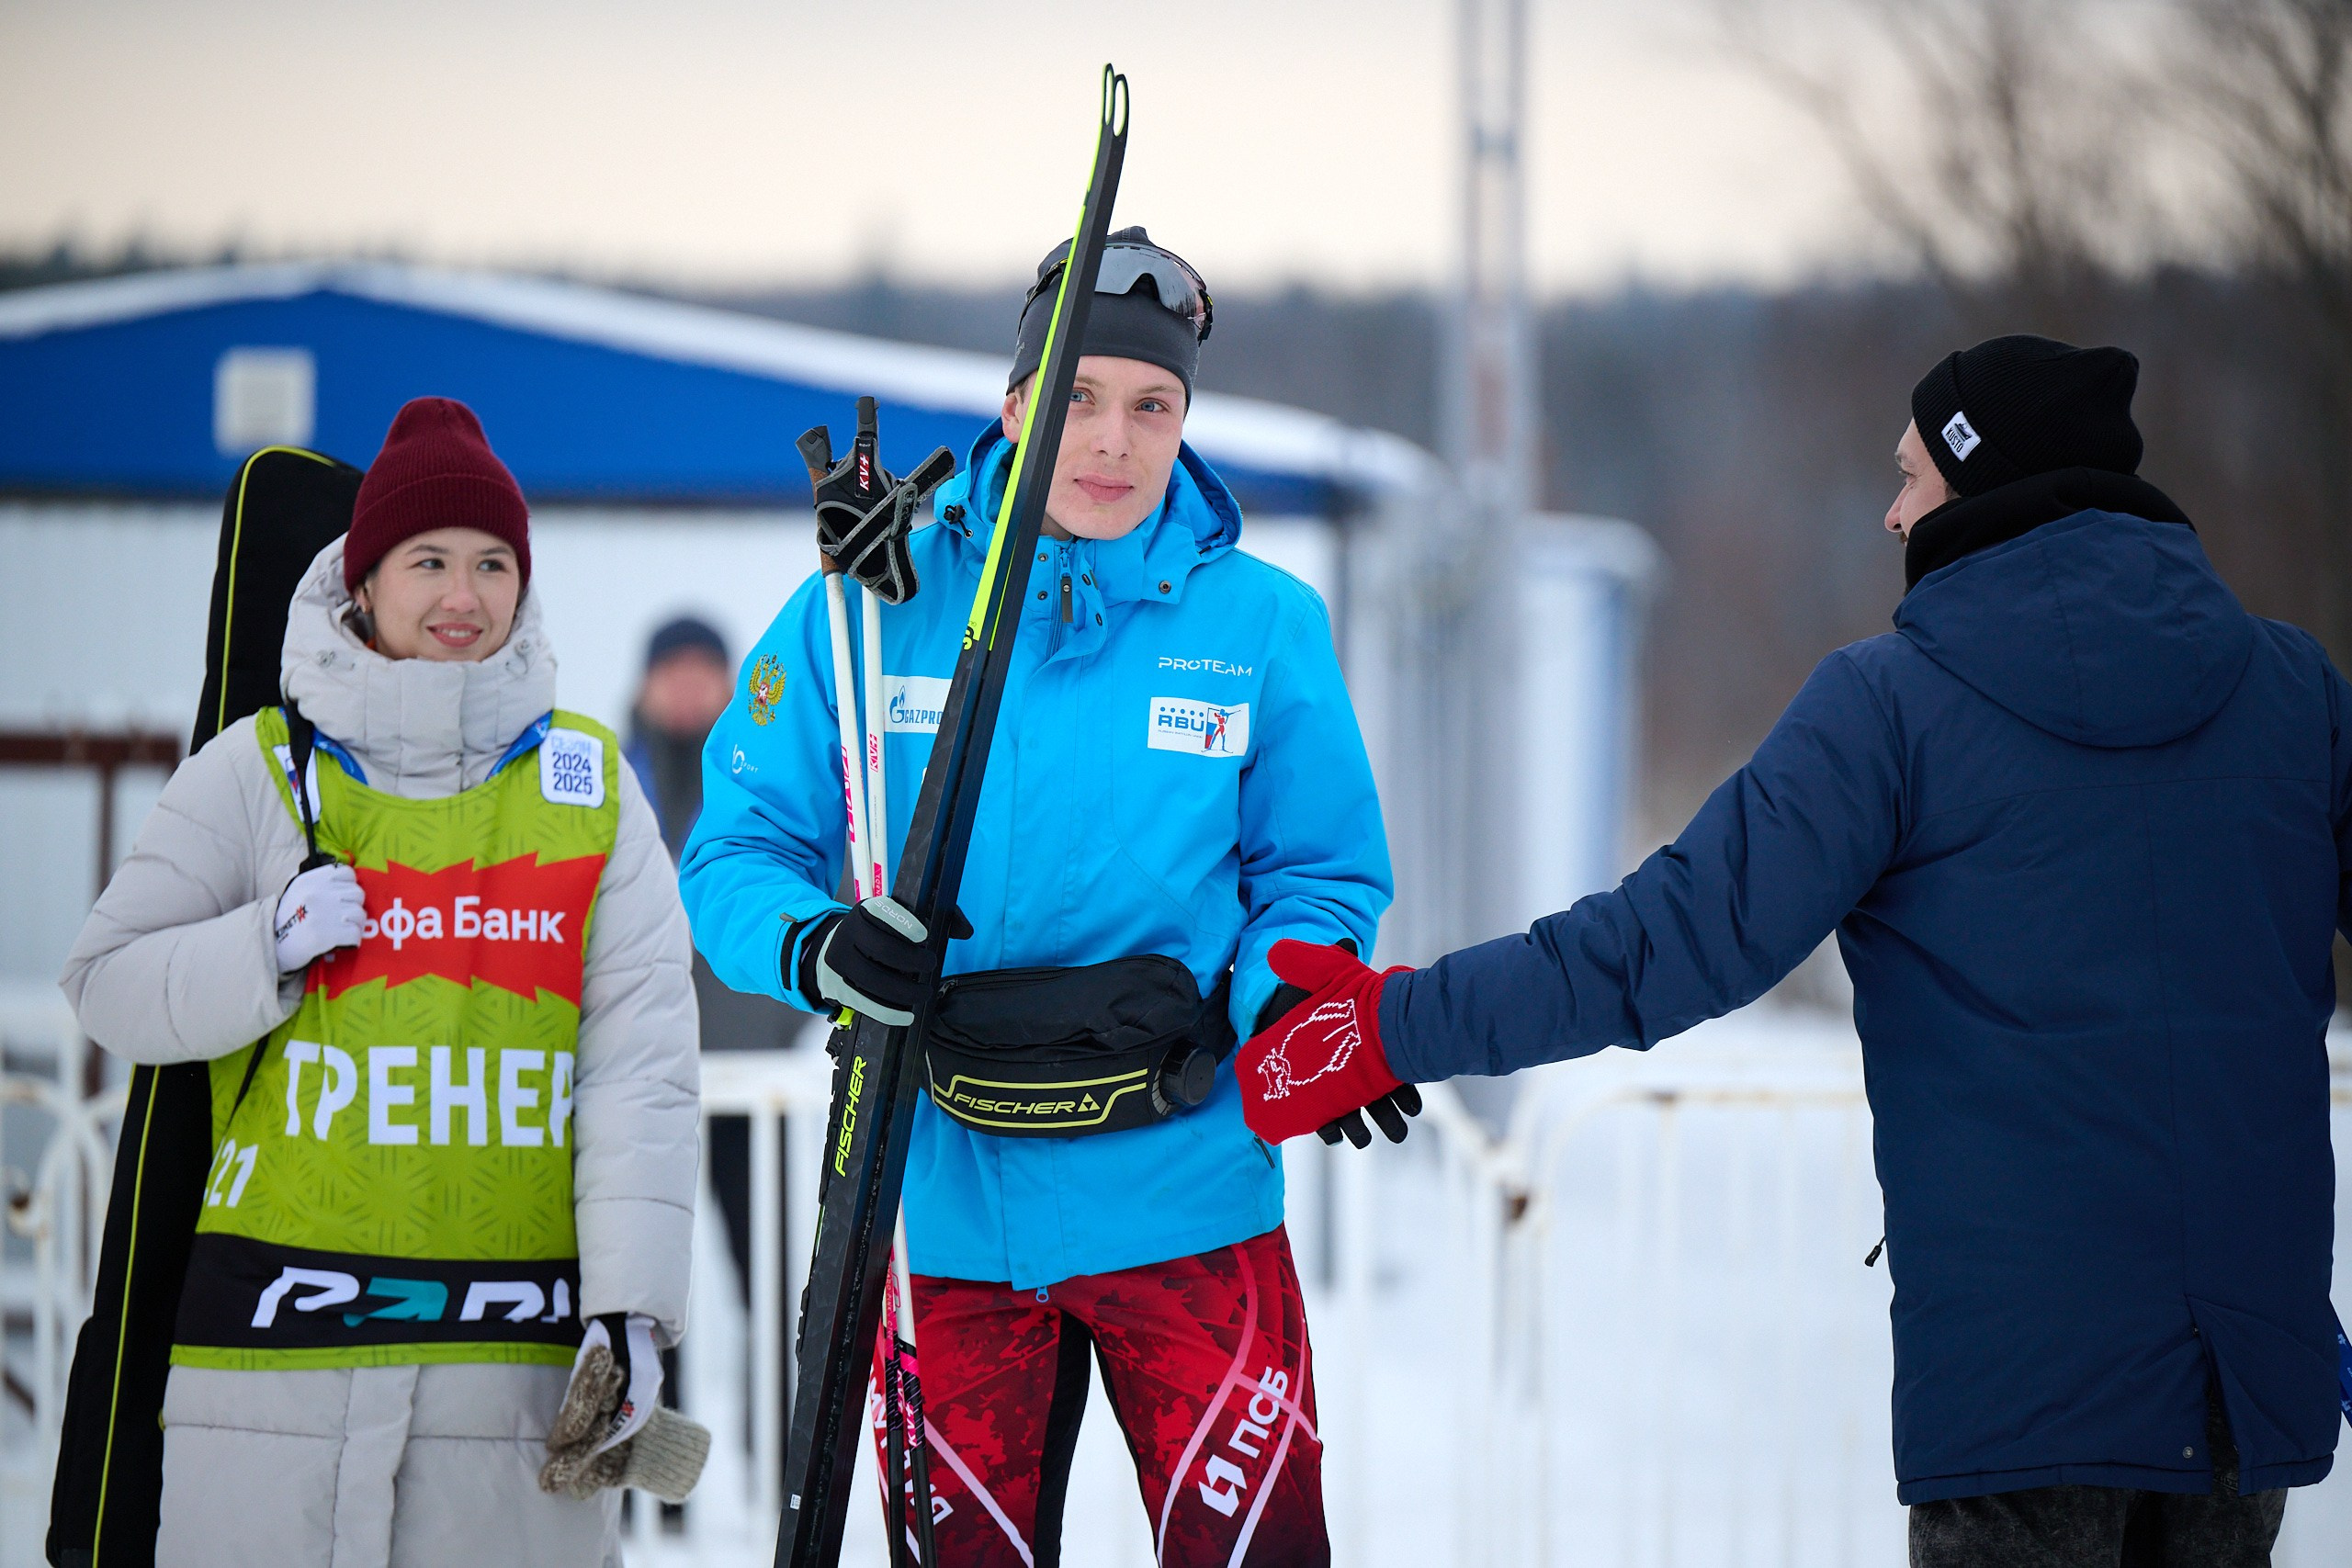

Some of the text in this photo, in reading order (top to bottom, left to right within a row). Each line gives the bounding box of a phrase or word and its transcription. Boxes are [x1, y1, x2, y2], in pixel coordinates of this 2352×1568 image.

[1945, 427, 1964, 453] KUSTO
[859, 454, 870, 491] KV+
[1158, 657, 1252, 677] PROTEAM
[904, 709, 944, 725] GAZPRO
[1158, 714, 1204, 732] RBU
[552, 751, 592, 773] 2024
[869, 733, 878, 773] KV+
[553, 772, 593, 795] 2025
[361, 895, 567, 951] ьфа Банк
[282, 1039, 575, 1148] ТРЕНЕР
[953, 1093, 1077, 1115] FISCHER
[833, 1055, 867, 1179] FISCHER
[203, 1143, 258, 1209] 21
[906, 1402, 919, 1449] KV+
[1228, 1365, 1290, 1459] ПСБ
